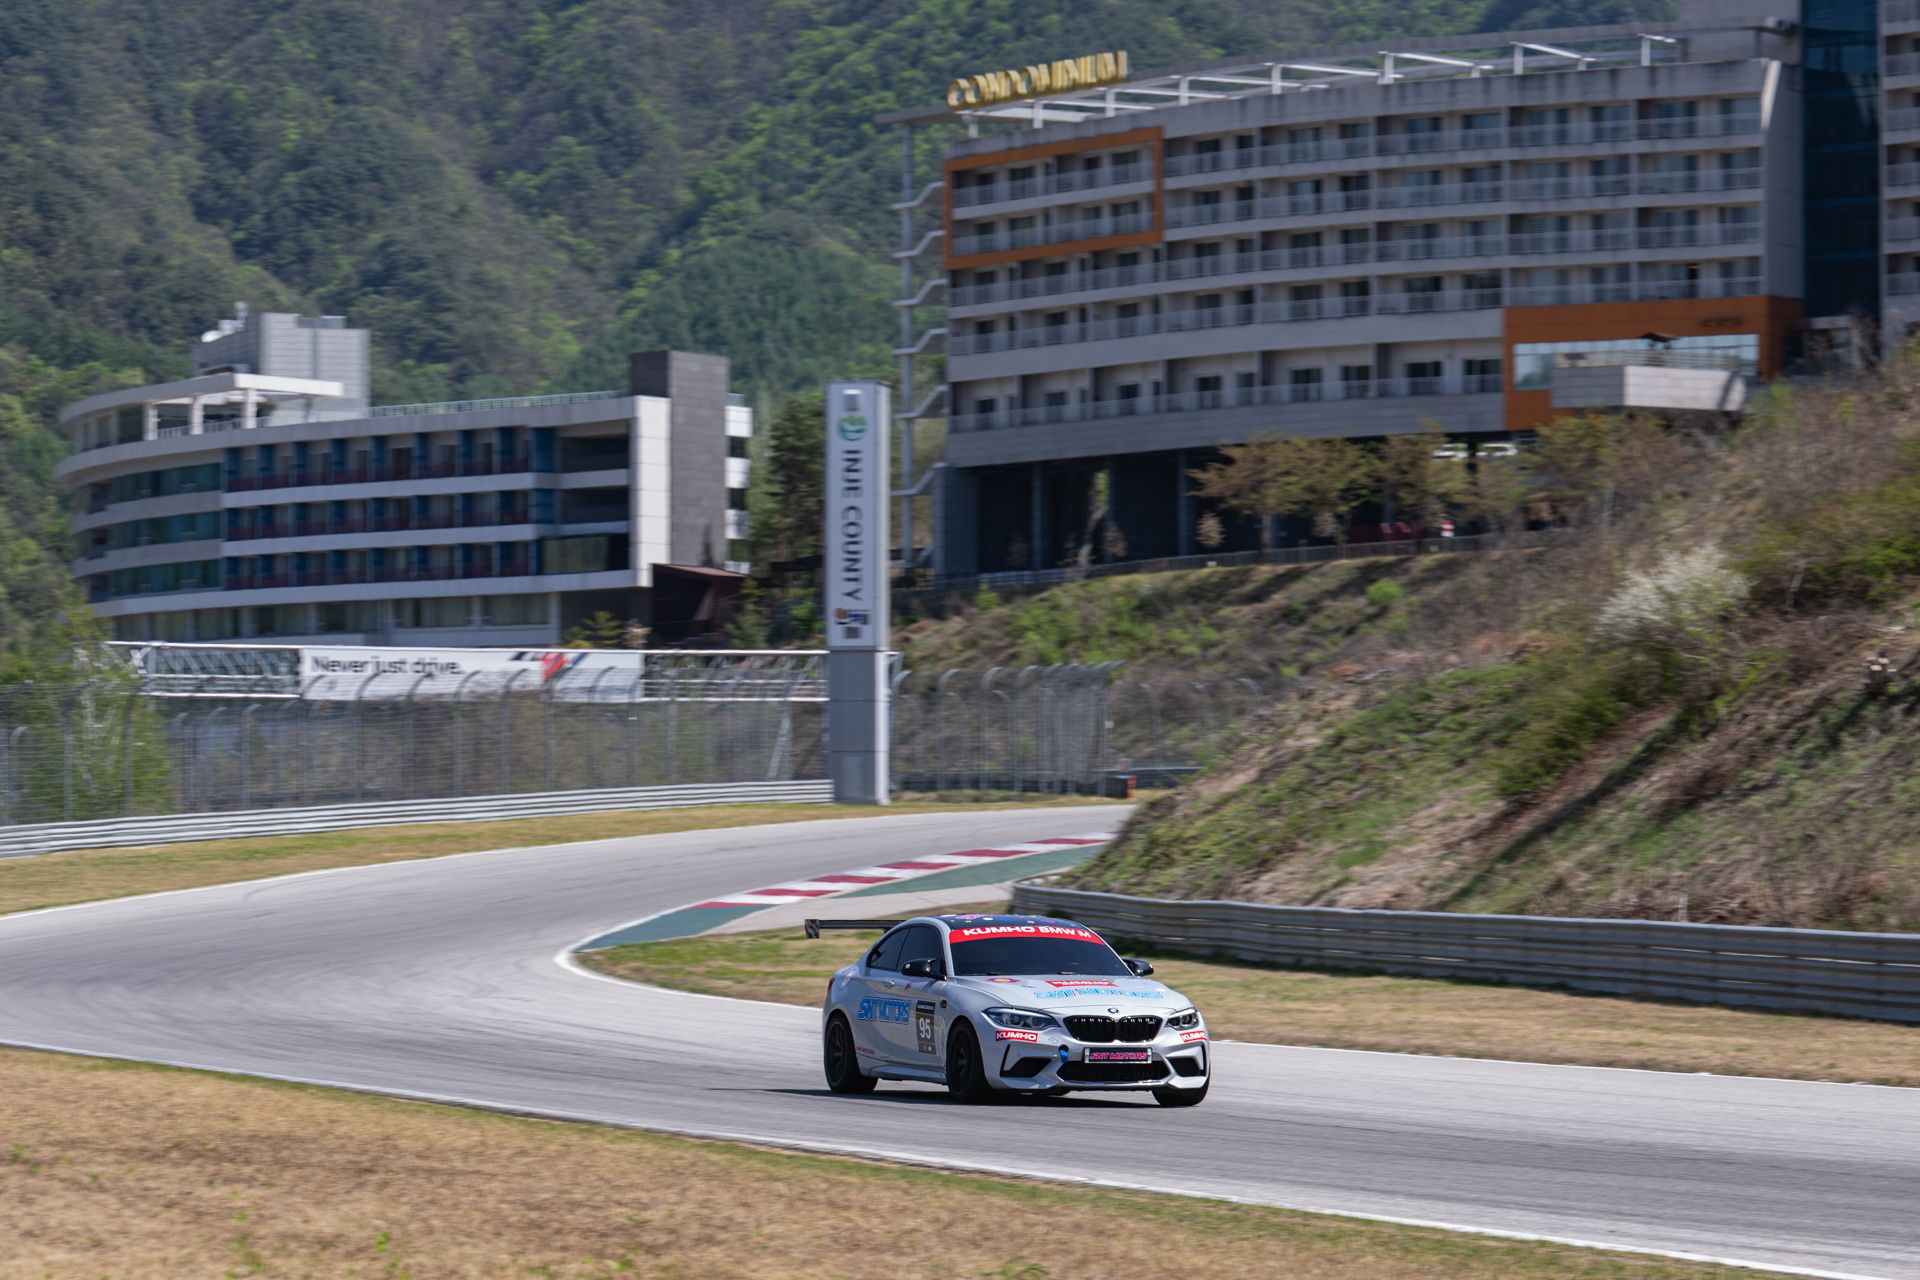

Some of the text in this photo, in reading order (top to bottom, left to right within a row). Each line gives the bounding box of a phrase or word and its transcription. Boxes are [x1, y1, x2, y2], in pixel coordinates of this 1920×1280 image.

[841, 449, 863, 600] INJE COUNTY
[311, 656, 368, 672] Never
[962, 925, 1091, 939] KUMHO BMW M
[919, 1018, 932, 1039] 95
[996, 1031, 1037, 1041] KUMHO
